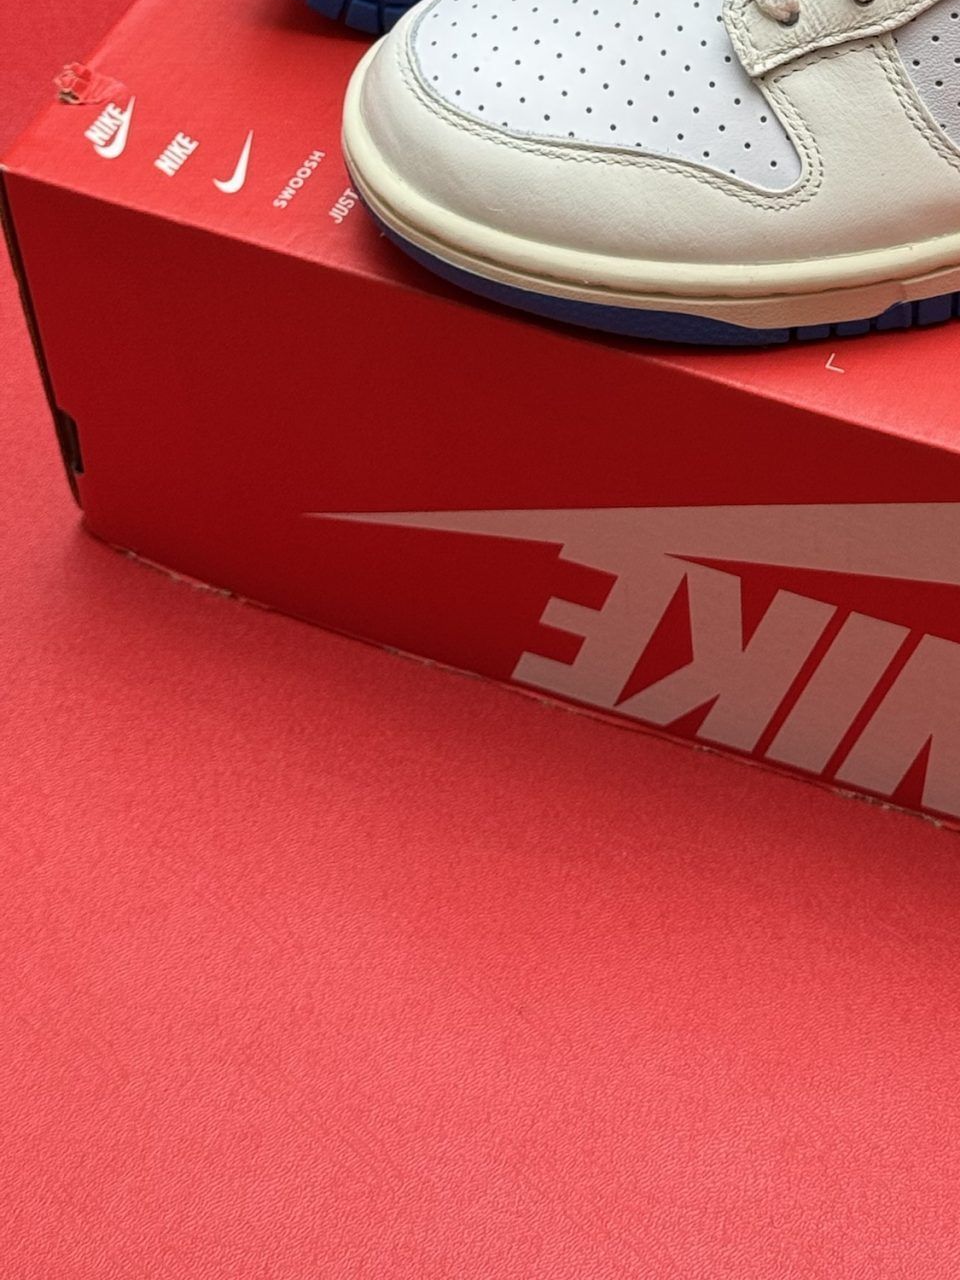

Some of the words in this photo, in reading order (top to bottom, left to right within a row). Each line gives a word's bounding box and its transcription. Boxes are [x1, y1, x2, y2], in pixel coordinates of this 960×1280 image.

[84, 103, 126, 147] NIKE
[154, 132, 200, 177] NIKE
[273, 150, 326, 209] SWOOSH
[328, 187, 359, 224] JUST
